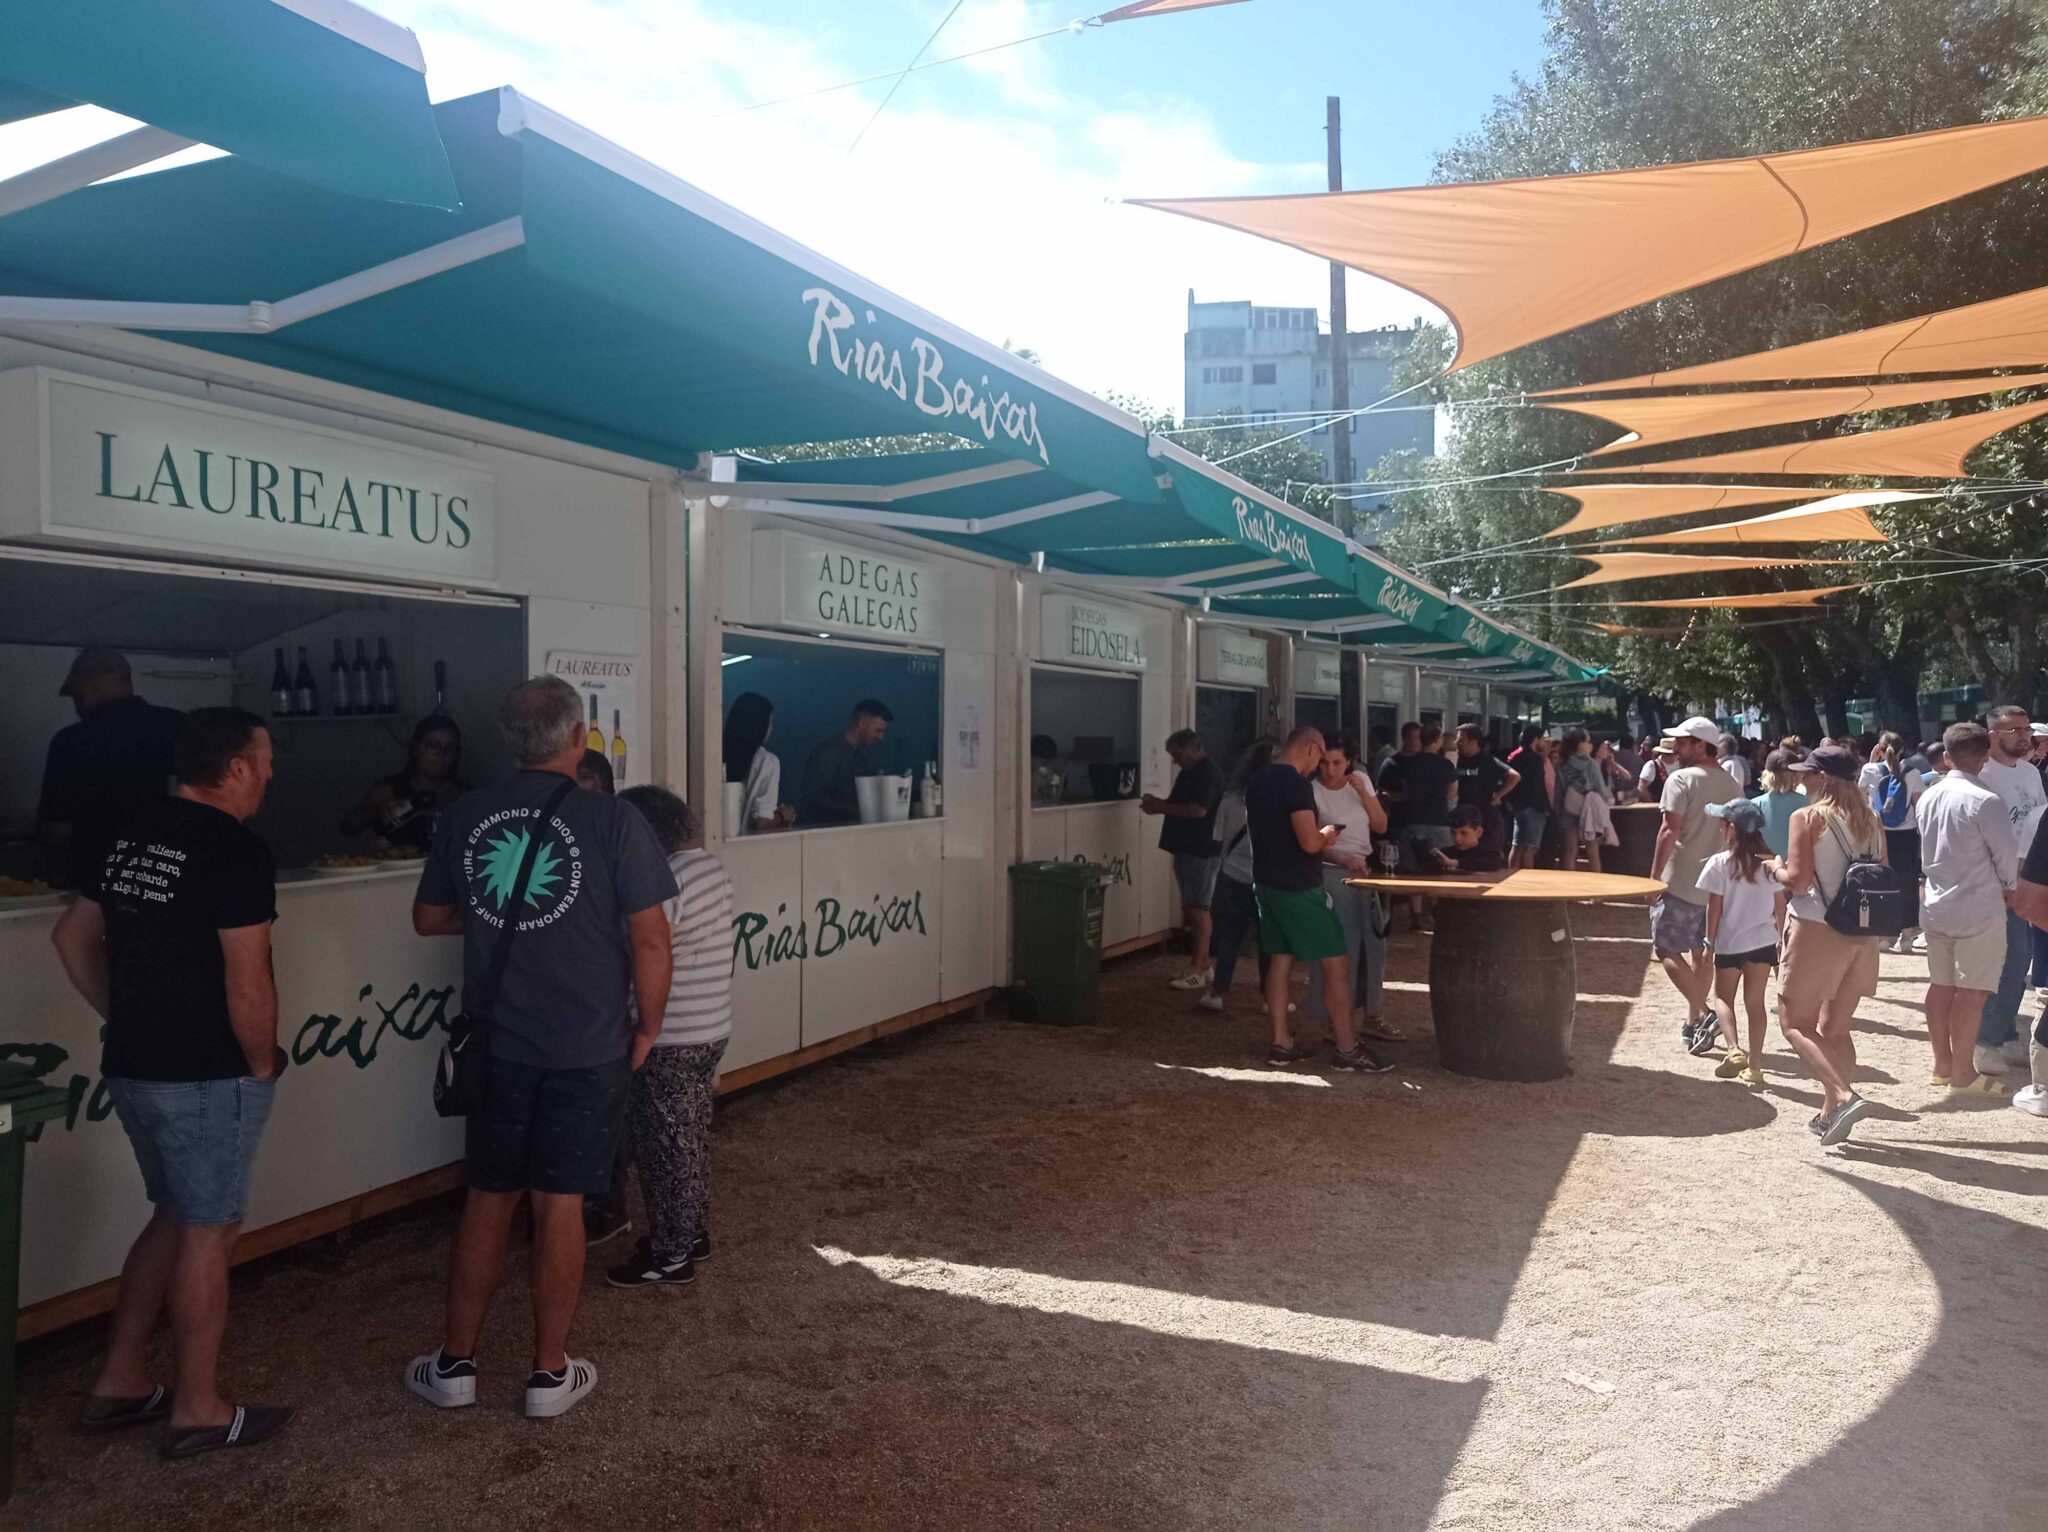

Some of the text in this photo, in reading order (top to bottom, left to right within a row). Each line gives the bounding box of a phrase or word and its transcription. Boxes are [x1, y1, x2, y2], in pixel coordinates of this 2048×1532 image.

[911, 337, 1049, 466] Baixas
[95, 431, 471, 549] LAUREATUS
[1264, 511, 1315, 570] Baixas
[819, 553, 918, 598] ADEGAS
[819, 591, 917, 633] GALEGAS
[1072, 605, 1107, 626] BODEGAS
[1071, 625, 1140, 664] EIDOSELA
[556, 659, 632, 676] LAUREATUS
[468, 808, 529, 845] EDMMOND
[532, 809, 575, 844] SDIOS
[121, 869, 135, 879] ser
[136, 870, 169, 888] cobarde
[156, 861, 181, 877] caro,
[515, 861, 582, 931] CONTEMPORAR
[815, 890, 926, 957] Baixas
